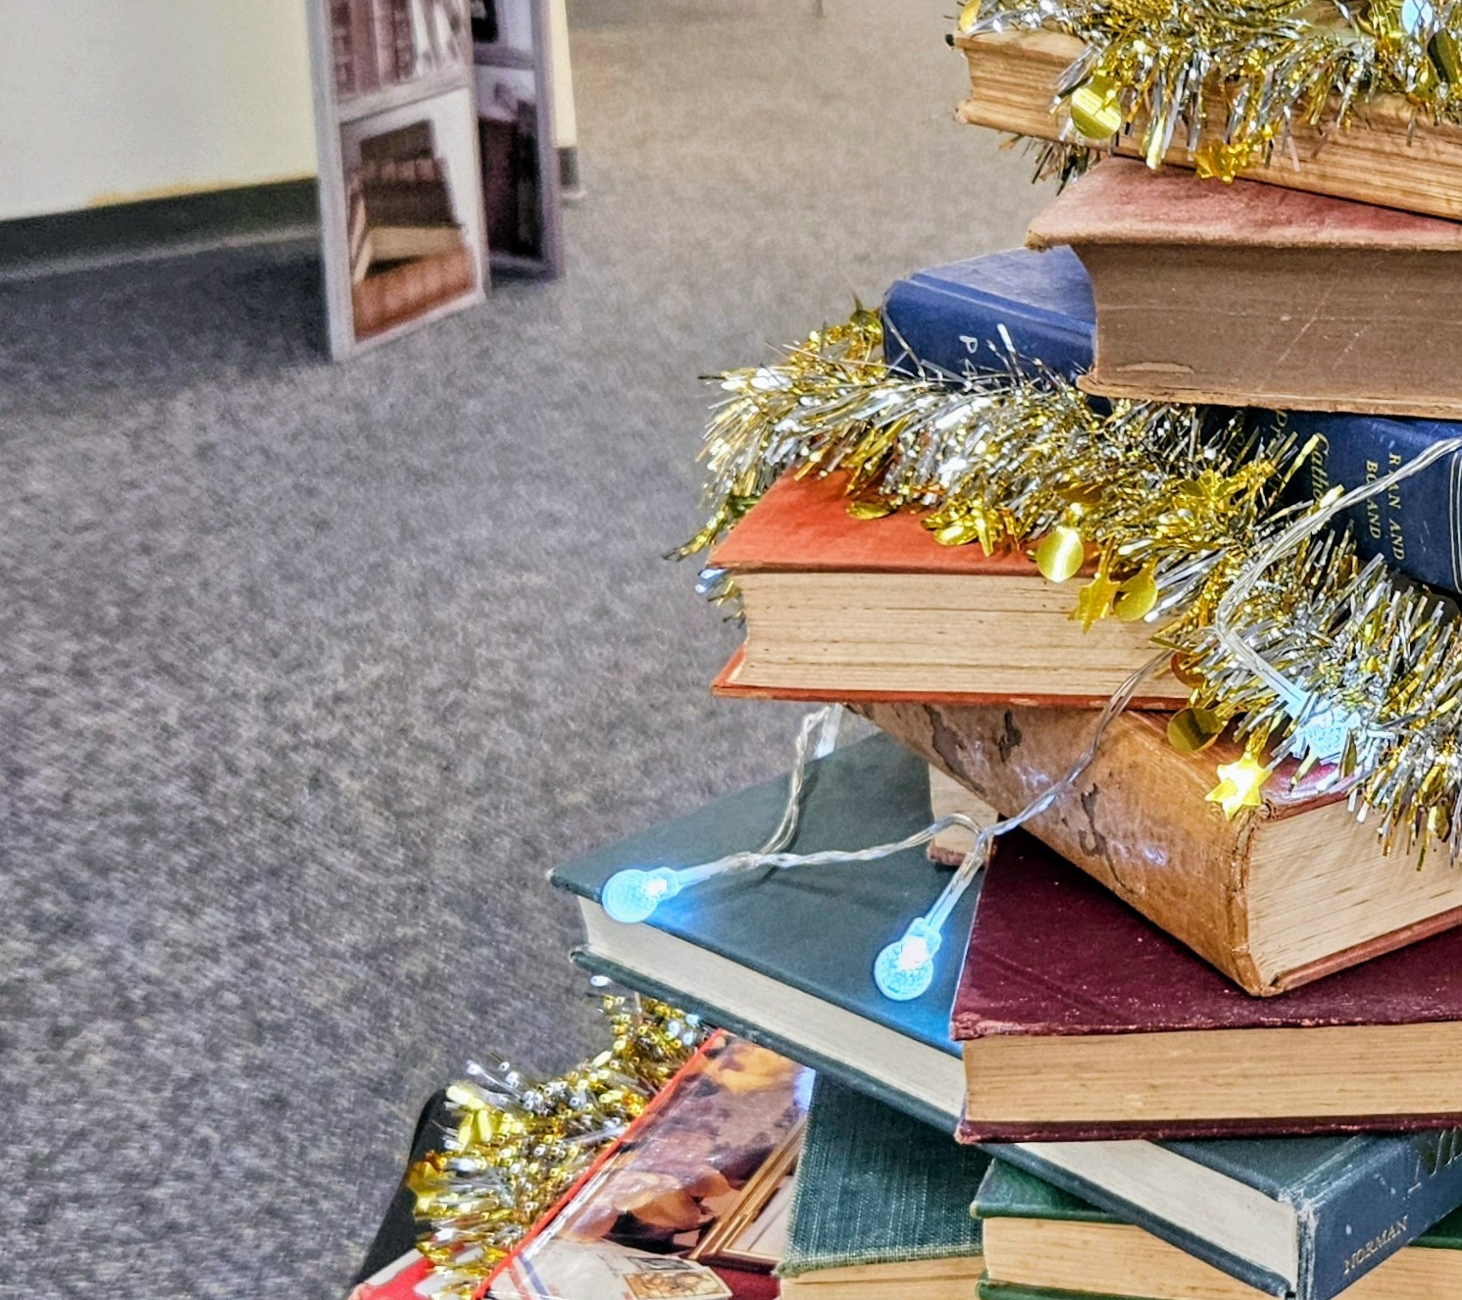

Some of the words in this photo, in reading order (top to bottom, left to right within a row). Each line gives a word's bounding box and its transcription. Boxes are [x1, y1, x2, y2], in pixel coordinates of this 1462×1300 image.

[1366, 459, 1382, 539] BOAND
[1388, 452, 1402, 510] RAN
[1389, 518, 1405, 560] AND
[1343, 1213, 1409, 1276] NORMAN
